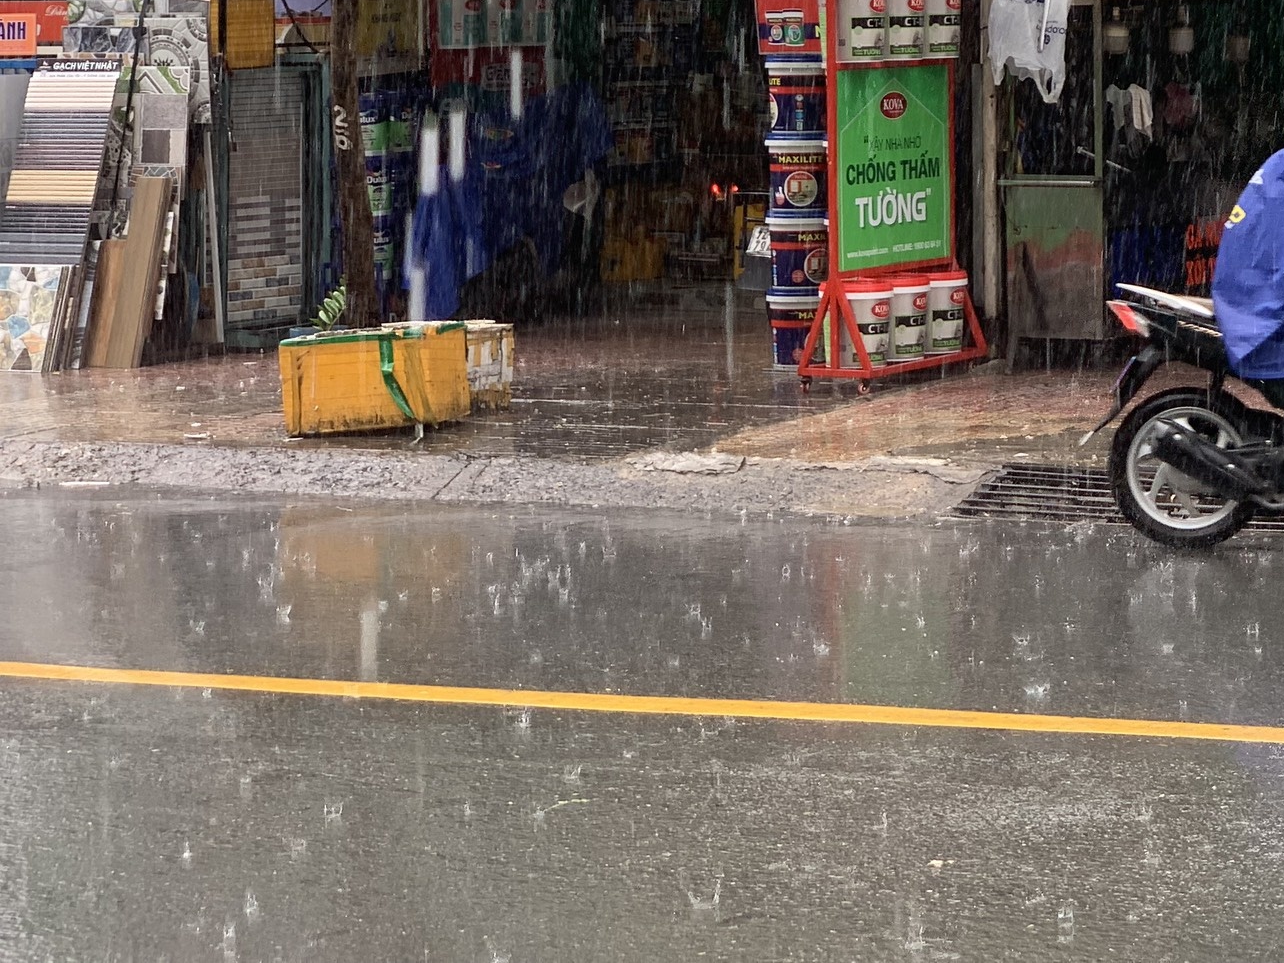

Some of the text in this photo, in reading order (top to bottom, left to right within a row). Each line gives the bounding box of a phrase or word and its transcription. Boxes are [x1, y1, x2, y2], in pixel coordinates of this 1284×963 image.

[883, 98, 904, 110] KOVA
[778, 154, 823, 164] MAXILITE
[846, 150, 940, 186] CHỐNG THẤM
